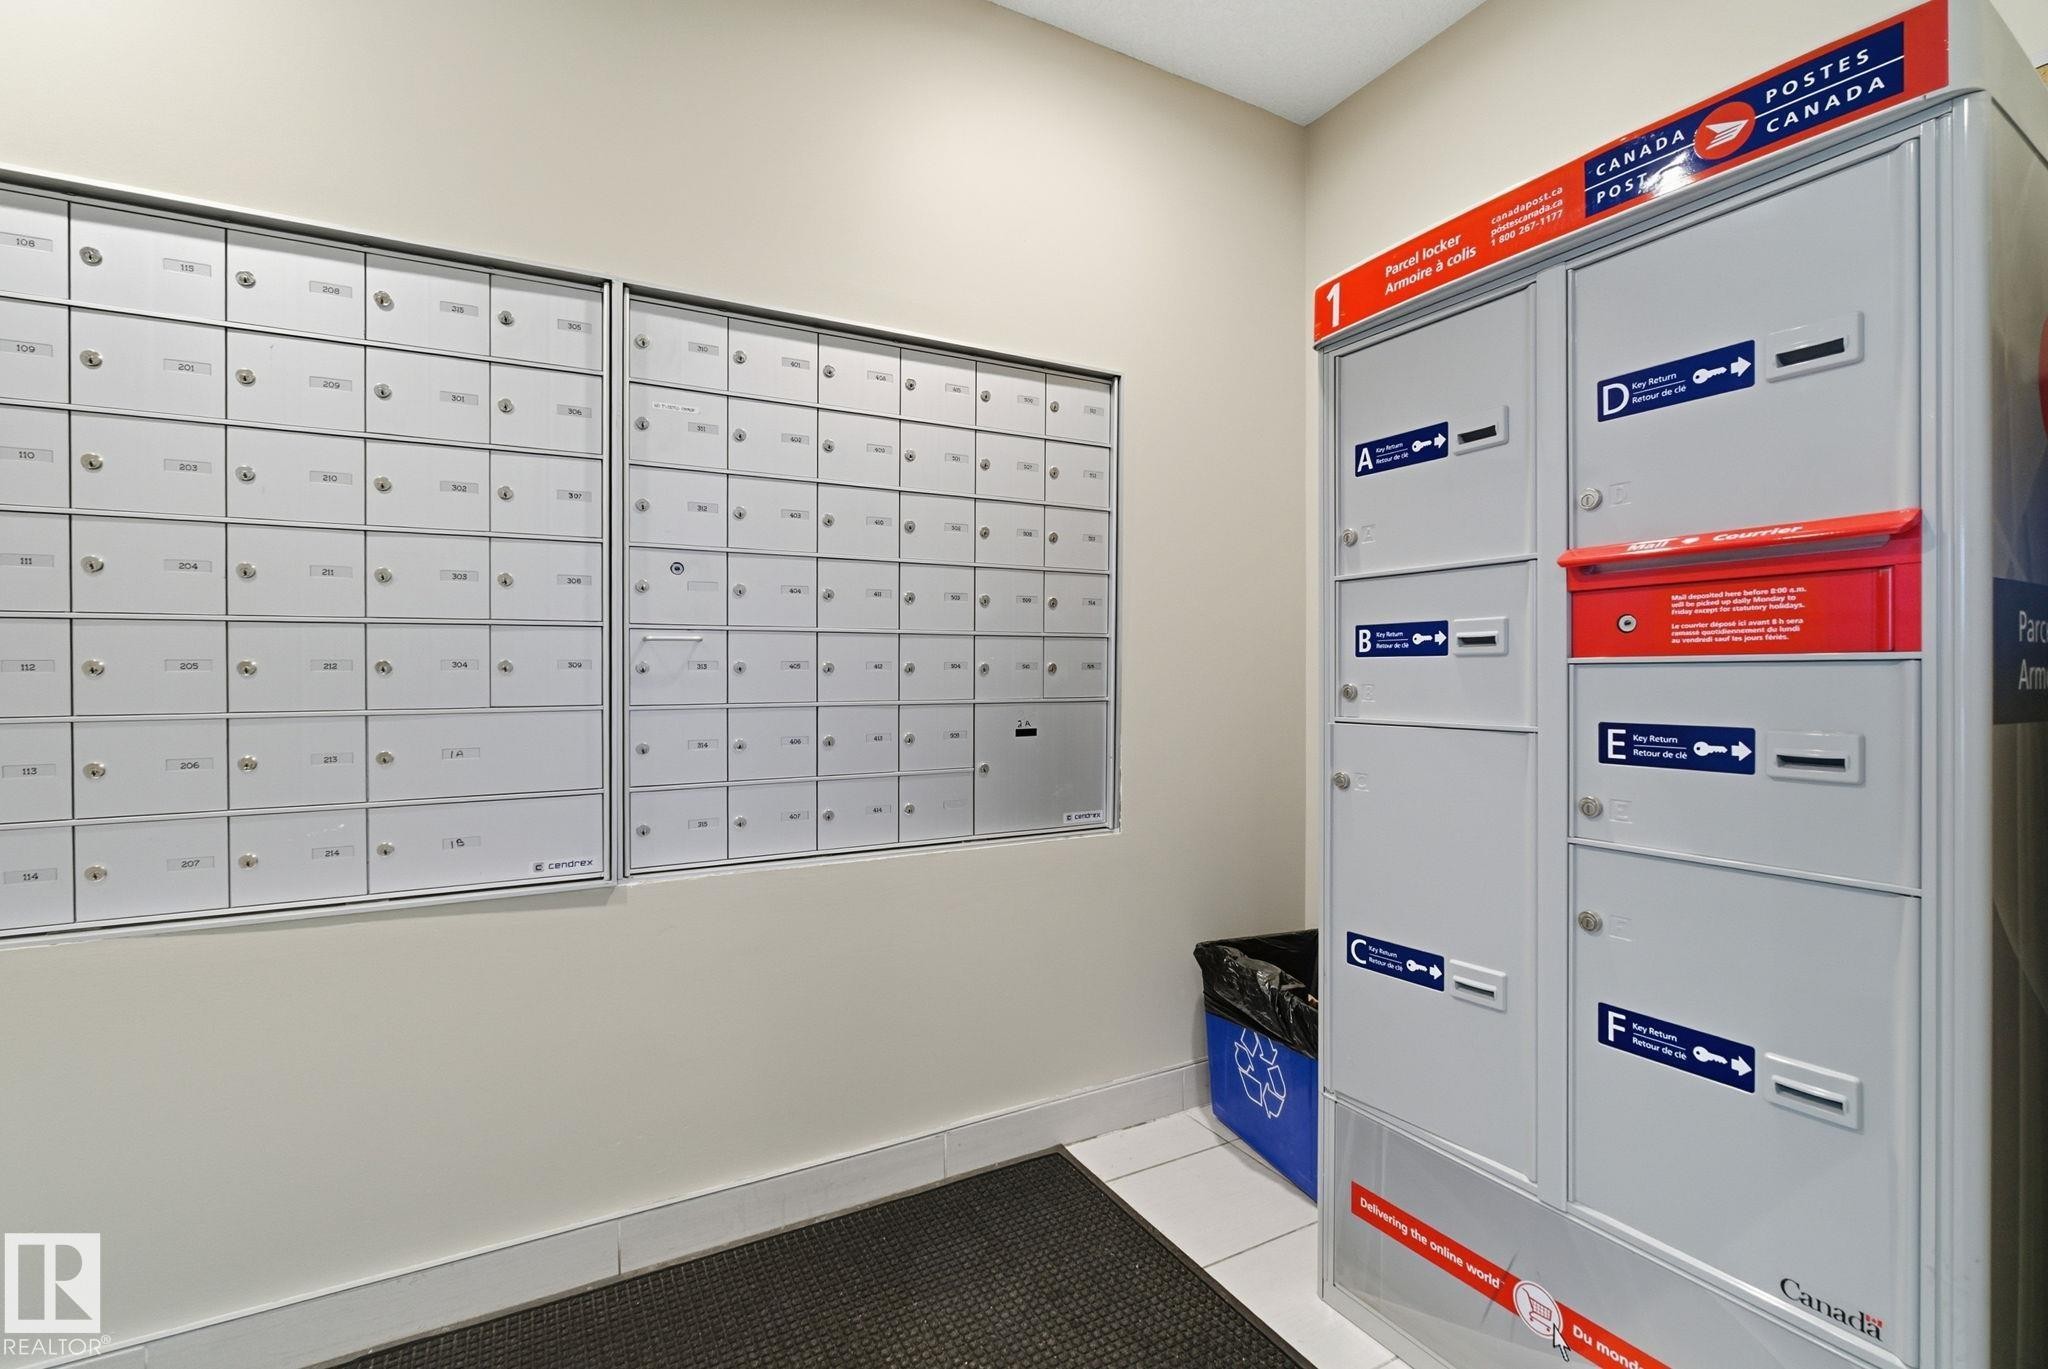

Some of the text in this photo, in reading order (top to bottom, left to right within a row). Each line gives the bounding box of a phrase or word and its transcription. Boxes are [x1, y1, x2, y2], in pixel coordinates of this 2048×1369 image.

[1766, 49, 1870, 104] POSTES
[1767, 77, 1885, 133] CANADA
[1596, 129, 1685, 177] CANADA
[1597, 173, 1646, 204] POST
[1491, 186, 1563, 223] canadapost.ca
[1491, 198, 1563, 236] postescanada.ca
[1499, 230, 1516, 244] 800
[1518, 209, 1563, 236] 267-1177
[1386, 232, 1461, 277] Parcel locker
[1385, 245, 1476, 295] Armoire à colis
[322, 286, 340, 294] 208
[1327, 282, 1340, 328] 1
[16, 344, 35, 353] 109
[178, 363, 195, 372] 201
[323, 381, 340, 389] 209
[1632, 372, 1677, 390] Key Return
[1603, 383, 1629, 416] D
[1632, 384, 1687, 404] Retour de clé
[18, 451, 35, 460] 110
[1386, 442, 1403, 450] Return
[179, 464, 197, 472] 203
[1357, 448, 1373, 472] A
[1626, 526, 1803, 551] Mail Courrier
[20, 557, 32, 565] 111
[178, 562, 198, 570] 204
[1688, 592, 1723, 600] deposited
[1359, 630, 1371, 652] B
[1702, 628, 1765, 636] quotidiennement
[180, 662, 198, 670] 205
[1608, 729, 1626, 759] E
[1633, 734, 1677, 744] Key Return
[1633, 748, 1687, 760] Retour de clé
[22, 767, 37, 775] 113
[181, 860, 200, 868] 207
[548, 858, 593, 870] cendrex
[23, 873, 39, 881] 114
[1351, 939, 1366, 964] C
[1369, 945, 1397, 958] Key Return
[1608, 1010, 1625, 1041] F
[1632, 1023, 1677, 1042] Key Return
[1632, 1038, 1687, 1060] Retour de clé
[1360, 1197, 1408, 1237] Delivering
[1410, 1227, 1428, 1246] the
[1430, 1241, 1463, 1267] online
[1780, 1278, 1883, 1341] Canada
[1573, 1325, 1644, 1369] Du mond
